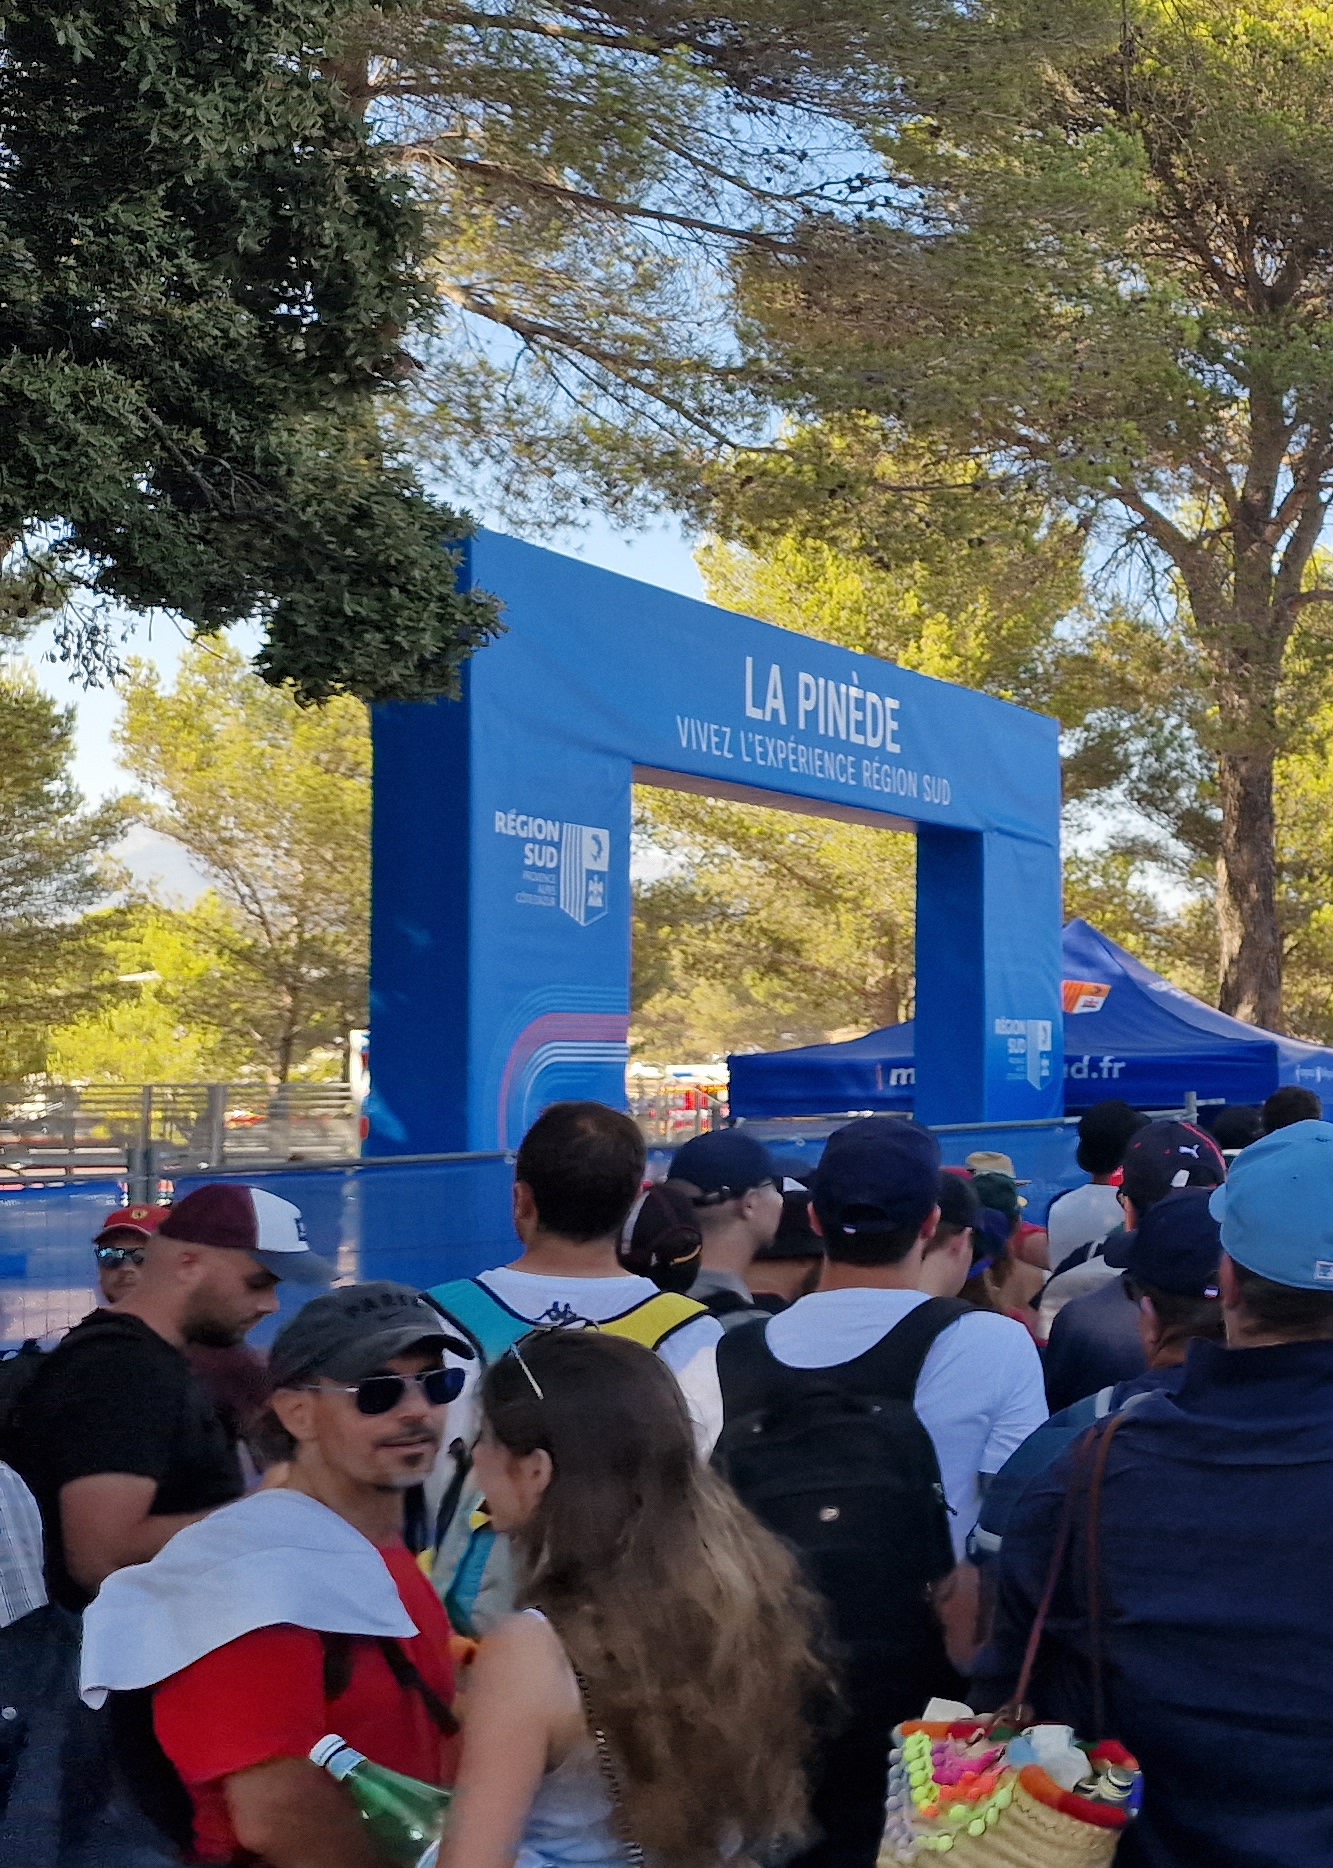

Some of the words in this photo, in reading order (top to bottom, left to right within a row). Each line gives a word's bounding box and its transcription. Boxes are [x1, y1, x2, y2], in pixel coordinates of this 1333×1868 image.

[745, 655, 787, 725] LA
[797, 670, 901, 754] PINÈDE
[676, 714, 734, 758] VIVEZ
[740, 730, 857, 786] L'EXPÉRIENCE
[861, 755, 918, 798] RÉGION
[922, 774, 952, 806] SUD
[494, 808, 560, 842] RÉGION
[524, 842, 559, 869] SUD
[889, 1067, 916, 1087] m
